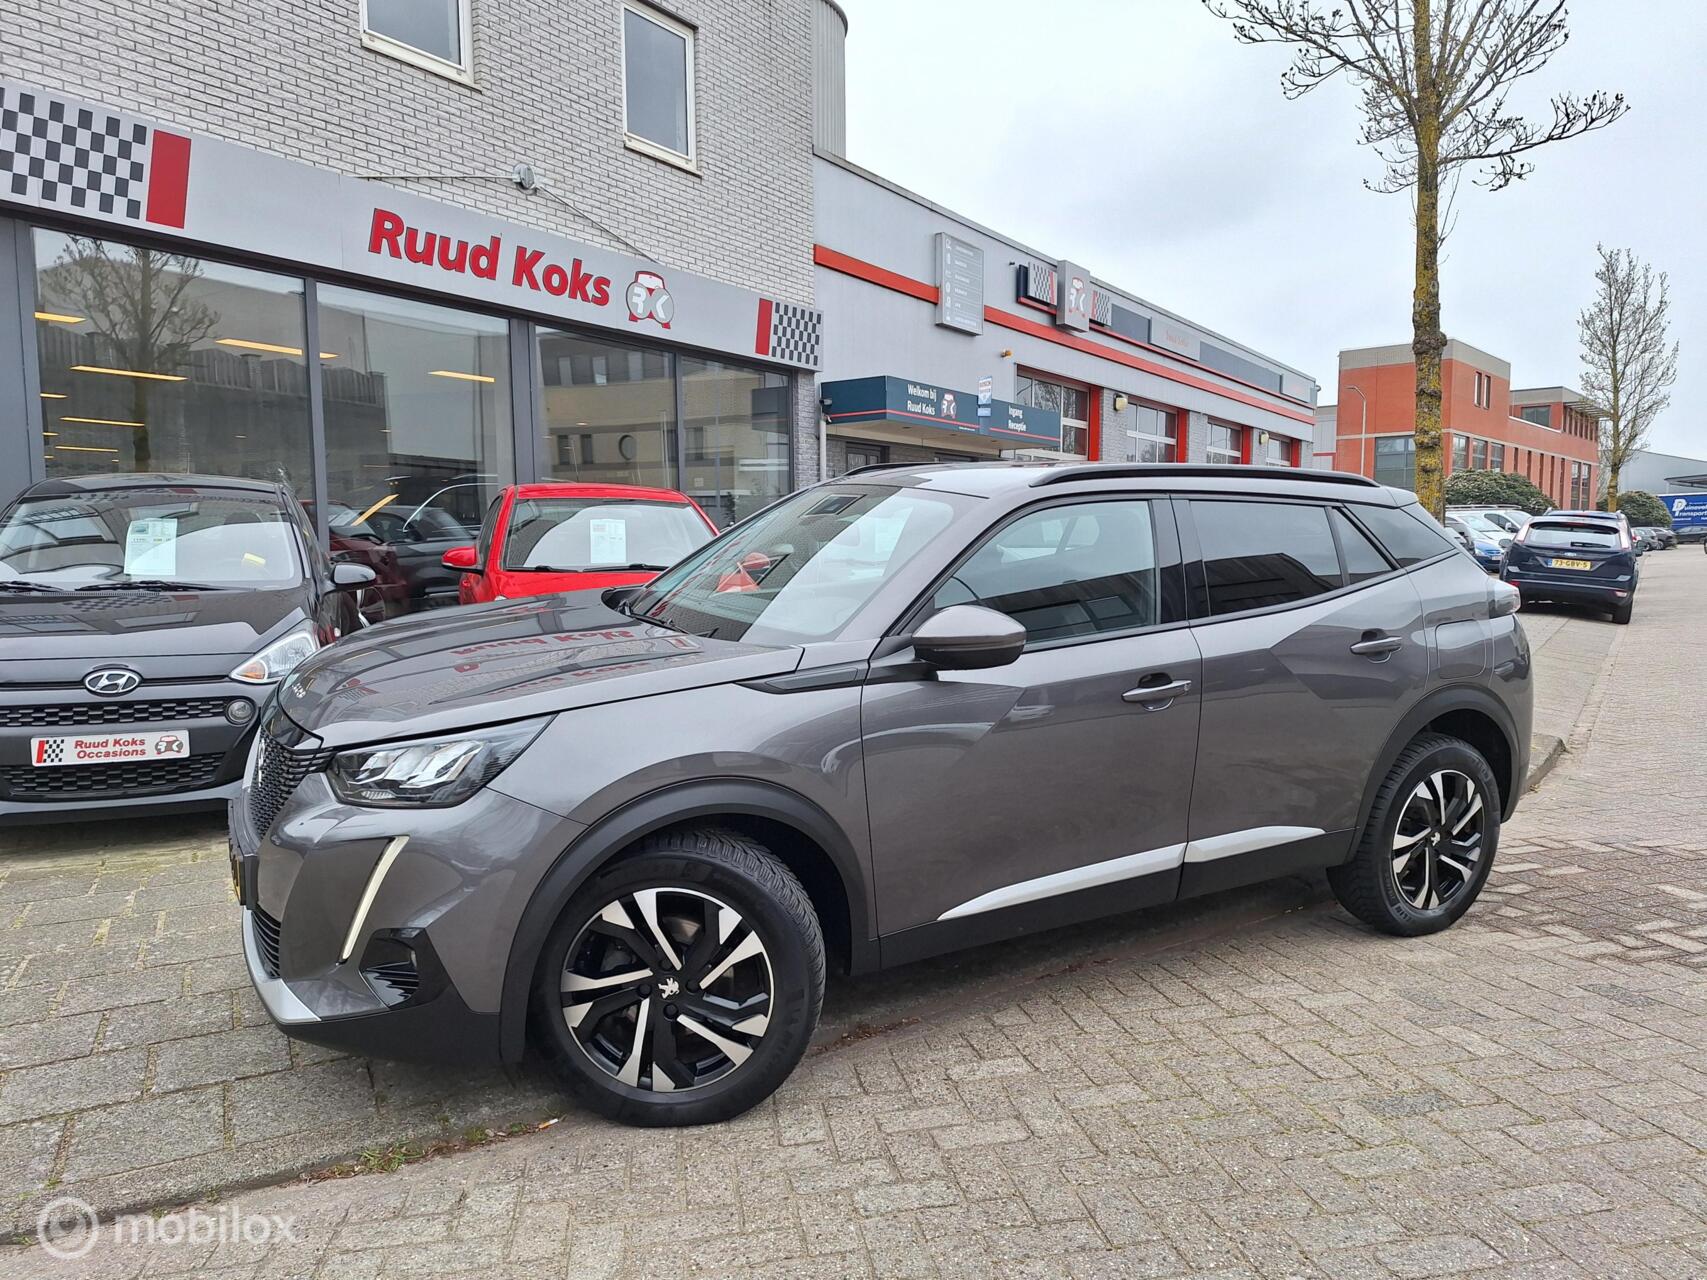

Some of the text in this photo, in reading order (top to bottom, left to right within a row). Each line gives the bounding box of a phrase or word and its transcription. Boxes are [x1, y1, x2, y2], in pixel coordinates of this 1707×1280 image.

[368, 207, 611, 307] Ruud Koks
[907, 383, 937, 402] Welkom bij
[907, 400, 936, 416] Ruud Koks
[74, 738, 146, 749] Ruud Koks
[76, 748, 147, 759] Occasions
